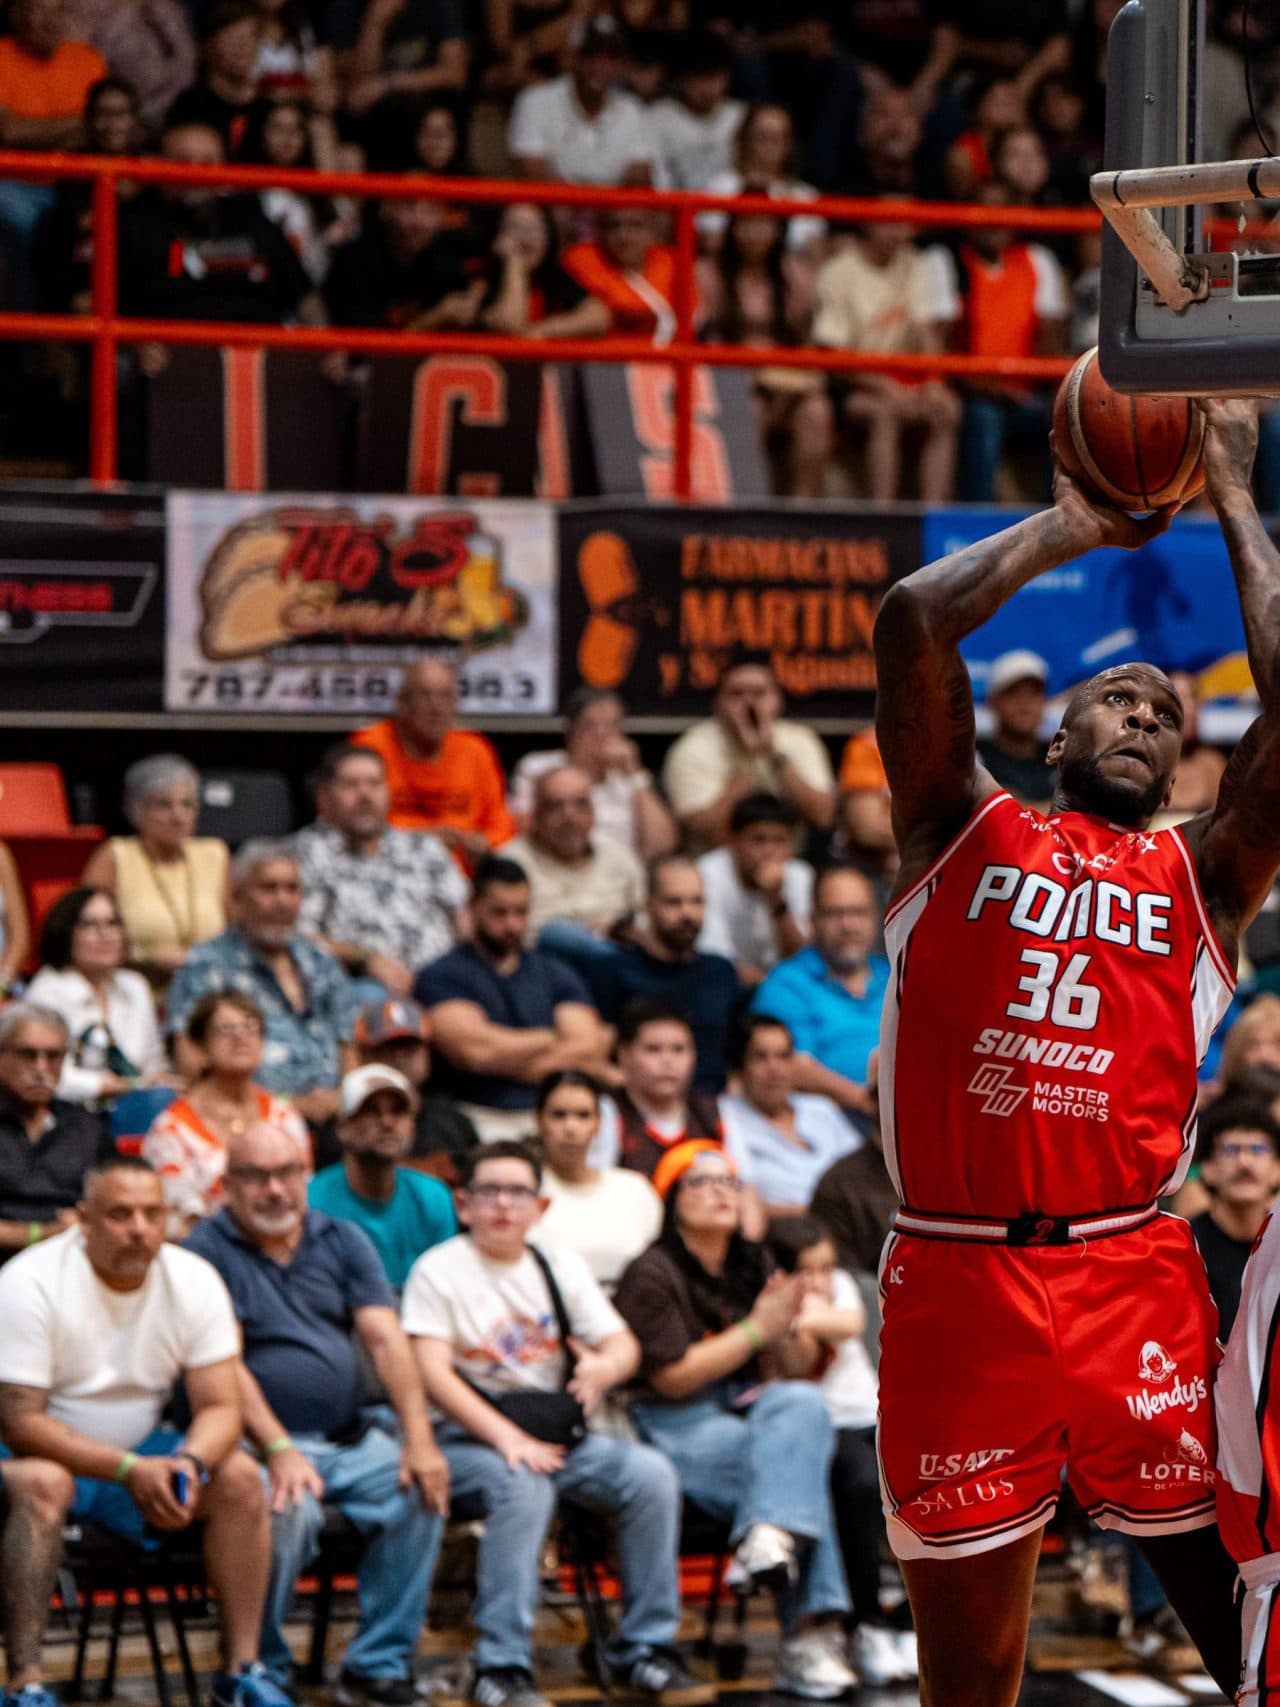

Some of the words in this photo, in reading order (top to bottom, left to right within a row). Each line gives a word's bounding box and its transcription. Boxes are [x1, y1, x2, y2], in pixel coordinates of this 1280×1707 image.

[966, 865, 1173, 956] PONCE
[1005, 948, 1102, 1031] 36
[973, 1027, 1115, 1075] SUNOCO
[1032, 1097, 1109, 1122] MOTORS
[1034, 1081, 1109, 1106] MASTER
[1126, 1374, 1208, 1421] Wendy's
[913, 1479, 1015, 1516] SALUS
